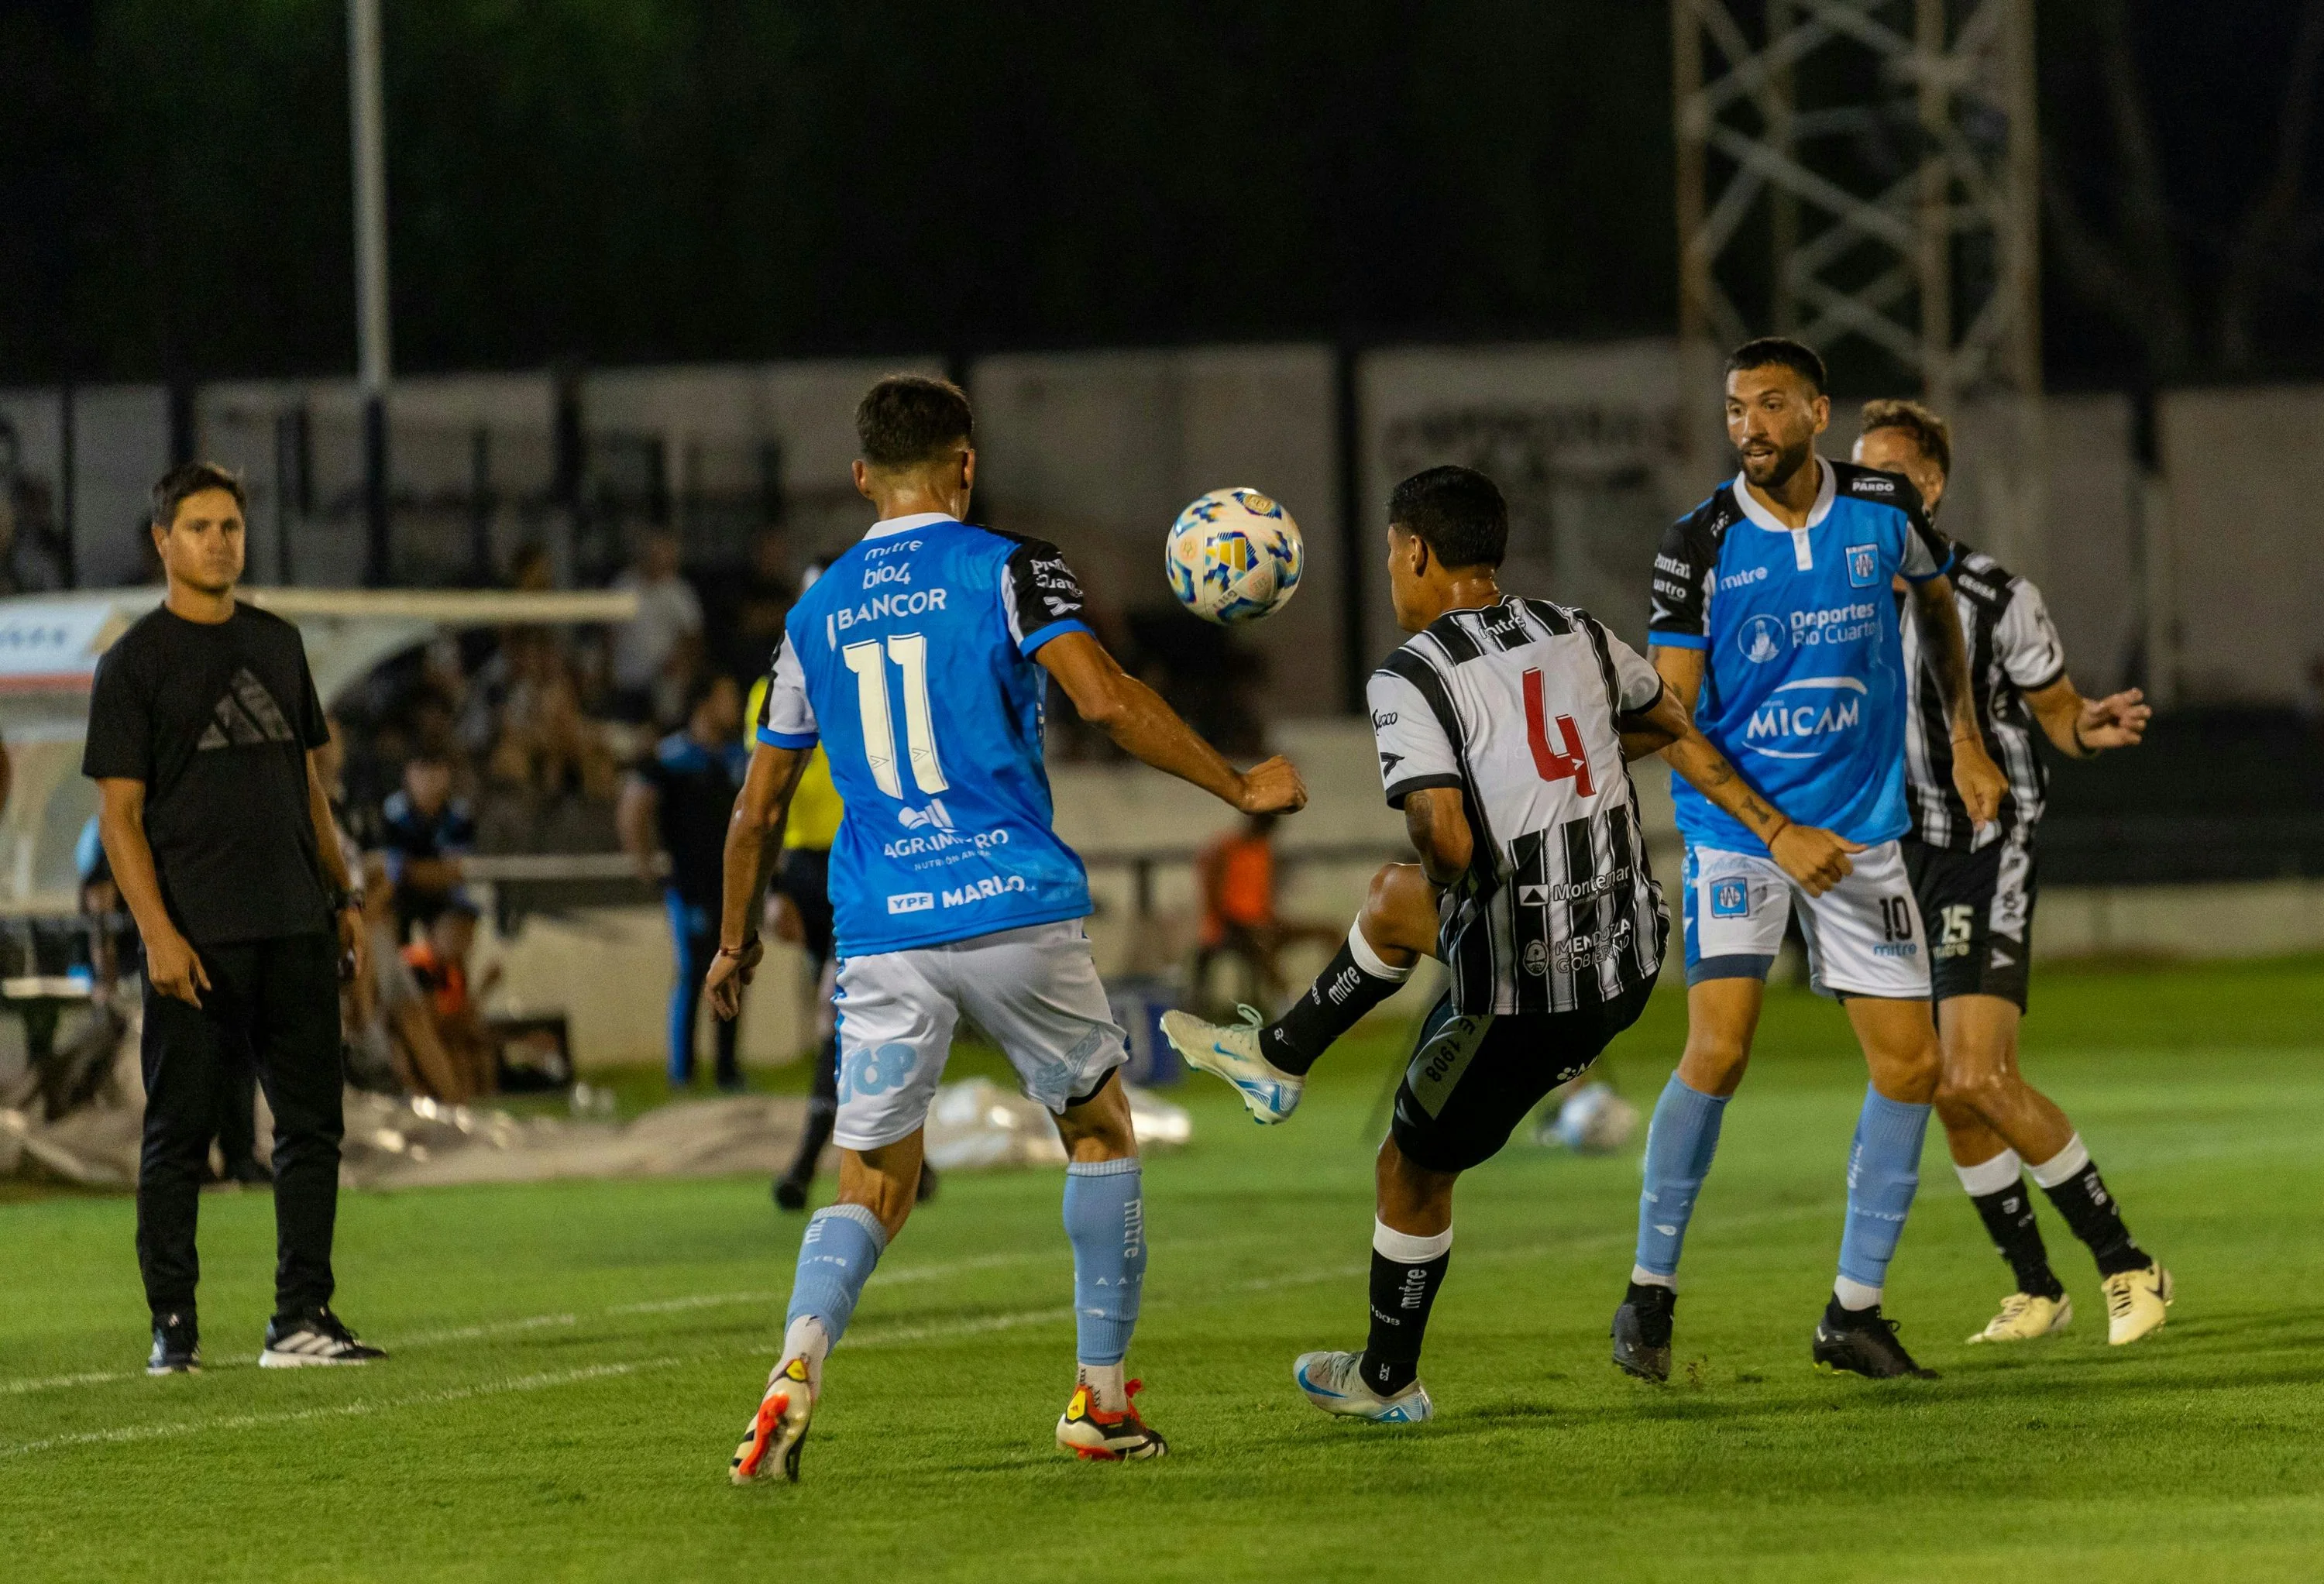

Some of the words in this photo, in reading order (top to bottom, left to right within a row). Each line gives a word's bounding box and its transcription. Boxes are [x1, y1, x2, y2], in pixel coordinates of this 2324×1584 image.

[864, 540, 923, 561] mitre
[862, 561, 911, 589] bio4
[1653, 578, 1687, 599] uatro
[1721, 566, 1768, 591] mitre
[838, 588, 947, 631] BANCOR
[1479, 616, 1527, 639] mitre
[1790, 603, 1875, 630] Deportes
[842, 631, 950, 800] 11
[1522, 666, 1597, 799] 4
[1746, 696, 1859, 739] MICAM
[892, 895, 930, 909] YPF
[1552, 865, 1630, 902] Montemar
[1879, 895, 1913, 943] 10
[1941, 905, 1974, 944] 15
[1873, 943, 1917, 957] mitre
[1328, 966, 1361, 1005] mitre
[1425, 1038, 1460, 1083] 1908
[1123, 1198, 1143, 1259] mitre
[1398, 1269, 1428, 1309] mitre
